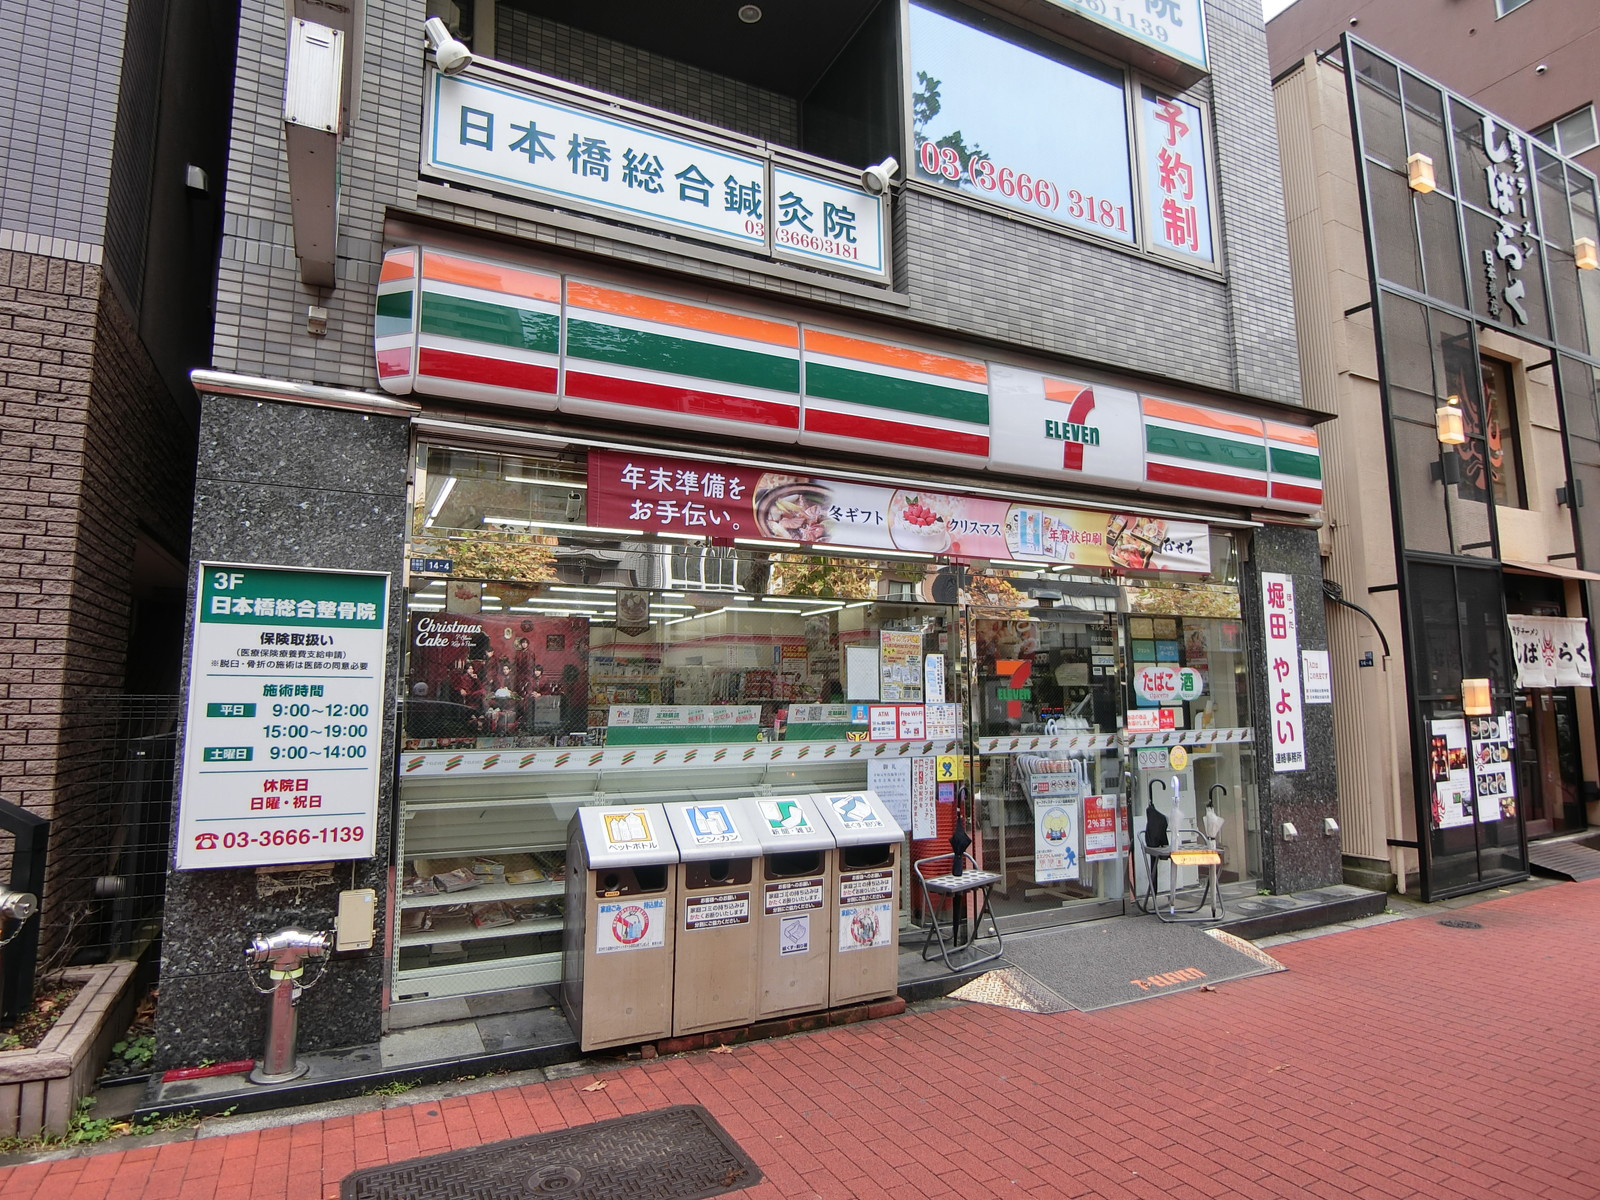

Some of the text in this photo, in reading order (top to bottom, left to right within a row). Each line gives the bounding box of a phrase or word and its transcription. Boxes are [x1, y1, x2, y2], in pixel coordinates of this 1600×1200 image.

[459, 105, 857, 244] 日本橋総合鍼灸院
[1154, 96, 1199, 253] 予約制
[920, 141, 1128, 233] 03 (3666) 3181
[1480, 116, 1529, 326] しばらく
[745, 219, 859, 261] 03 (3666)3181
[620, 463, 746, 500] 年末準備を
[629, 499, 741, 531] お手伝い。
[828, 505, 884, 526] 冬ギフト
[949, 518, 1002, 537] クリスマス
[1048, 528, 1102, 546] 年賀状印刷
[1163, 537, 1194, 555] おせち
[429, 561, 450, 570] 14-4
[213, 572, 245, 590] 3F
[211, 596, 376, 621] 日本橋総合整骨院
[417, 617, 482, 634] Christmas
[260, 632, 333, 647] 保険取扱い
[415, 633, 450, 647] Cake
[263, 684, 324, 698] 施術時間
[1143, 672, 1194, 692] たばこ 酒
[220, 704, 244, 716] 平日
[211, 747, 248, 760] 土曜日
[263, 778, 309, 793] 休院日
[250, 795, 322, 810] 日曜・祝日
[223, 826, 364, 849] 03-3666-1139
[608, 842, 658, 851] ペットボトル
